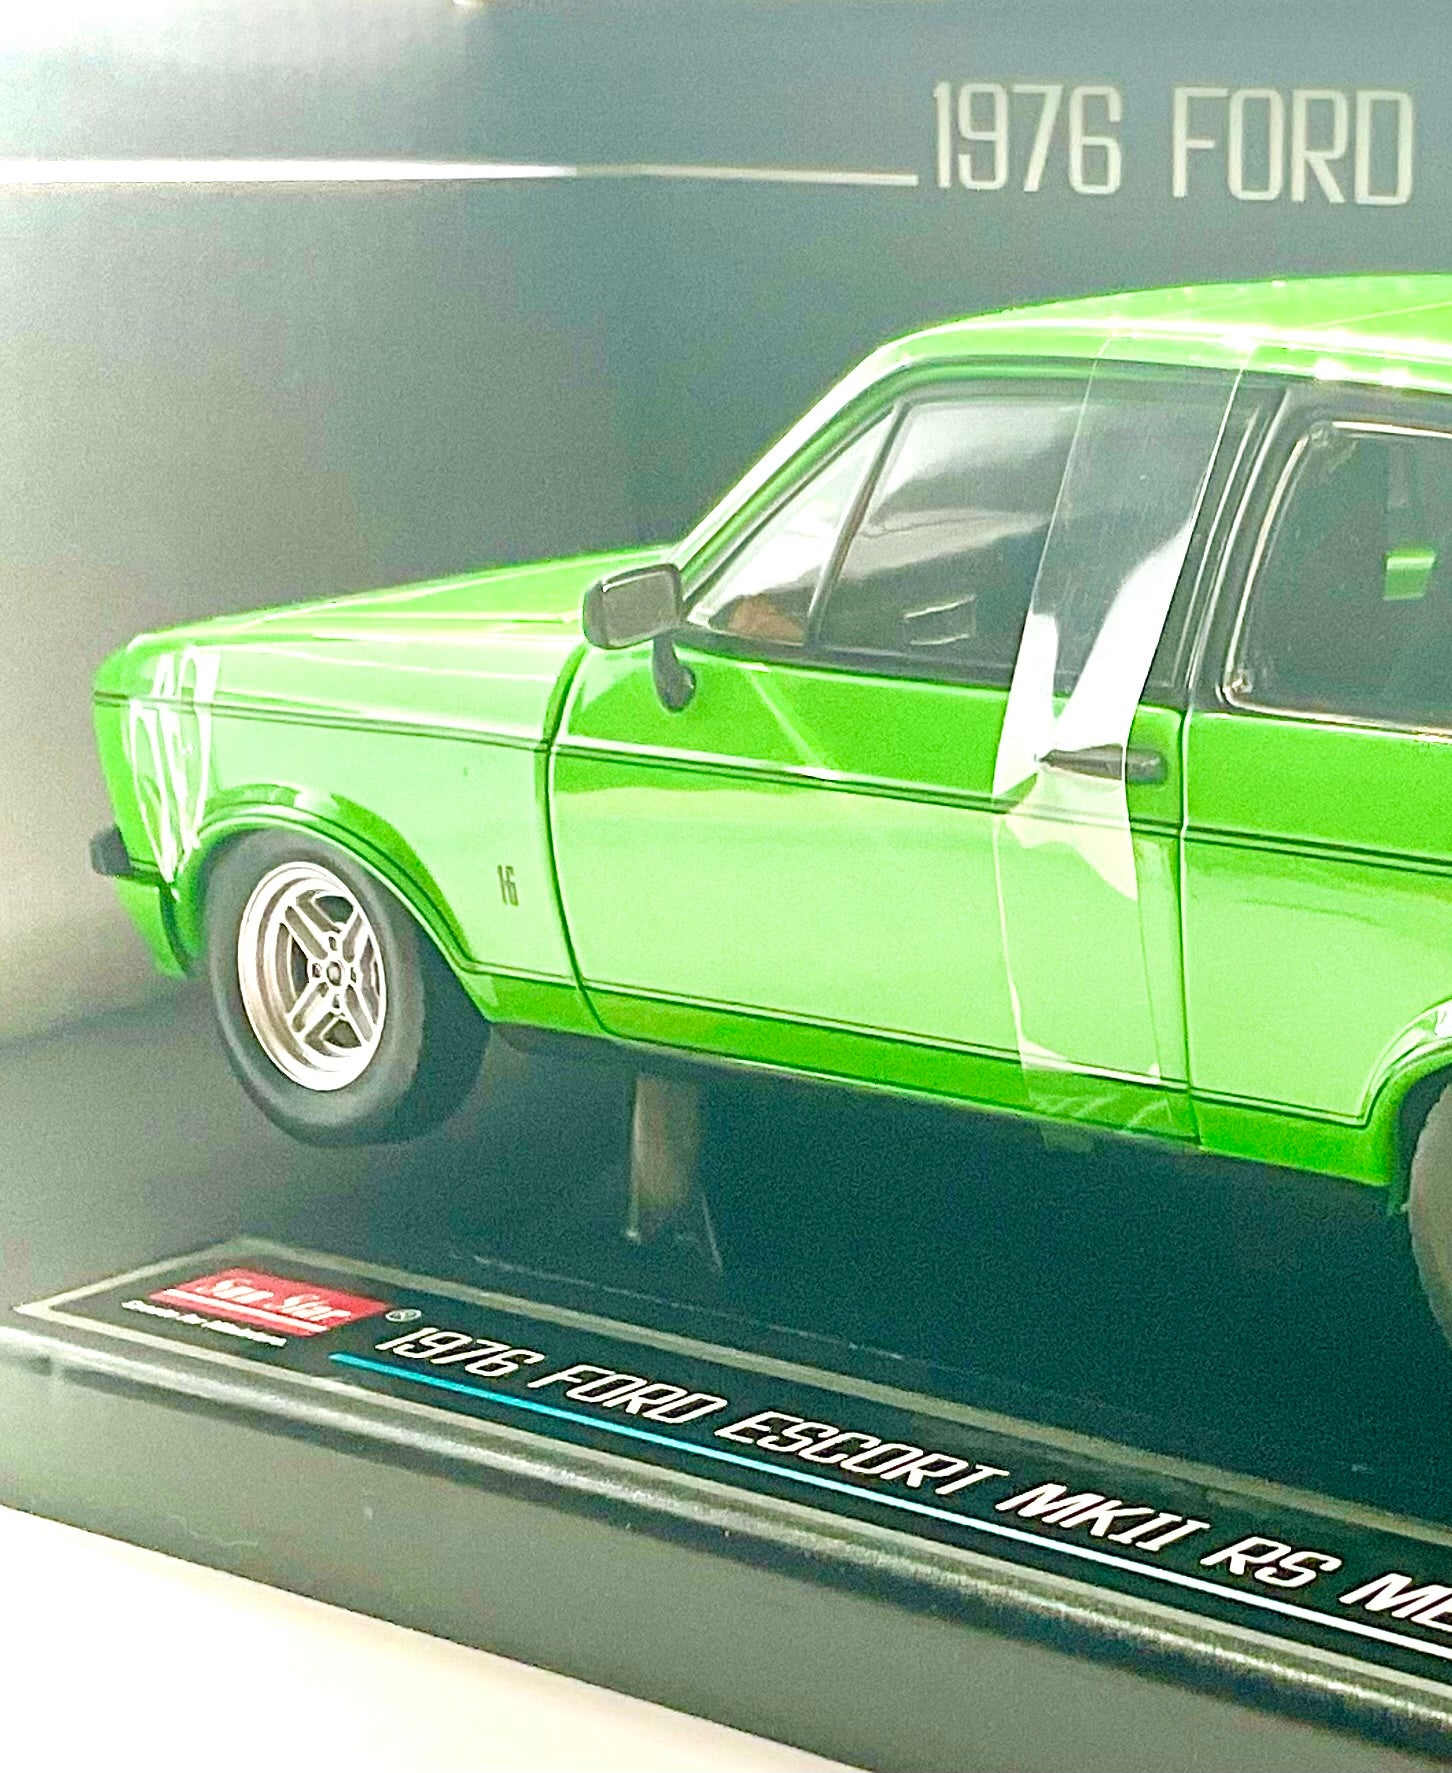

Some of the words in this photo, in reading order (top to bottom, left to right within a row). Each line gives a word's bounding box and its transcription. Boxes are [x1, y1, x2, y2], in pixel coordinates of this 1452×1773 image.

[932, 82, 1123, 195] 1976
[1172, 87, 1413, 206] FORD
[497, 864, 520, 907] 16
[374, 1326, 545, 1378] 1976
[526, 1364, 729, 1425] FORD
[714, 1409, 1010, 1496] ESCORT
[993, 1483, 1212, 1553] MKII
[1199, 1535, 1342, 1589] RS
